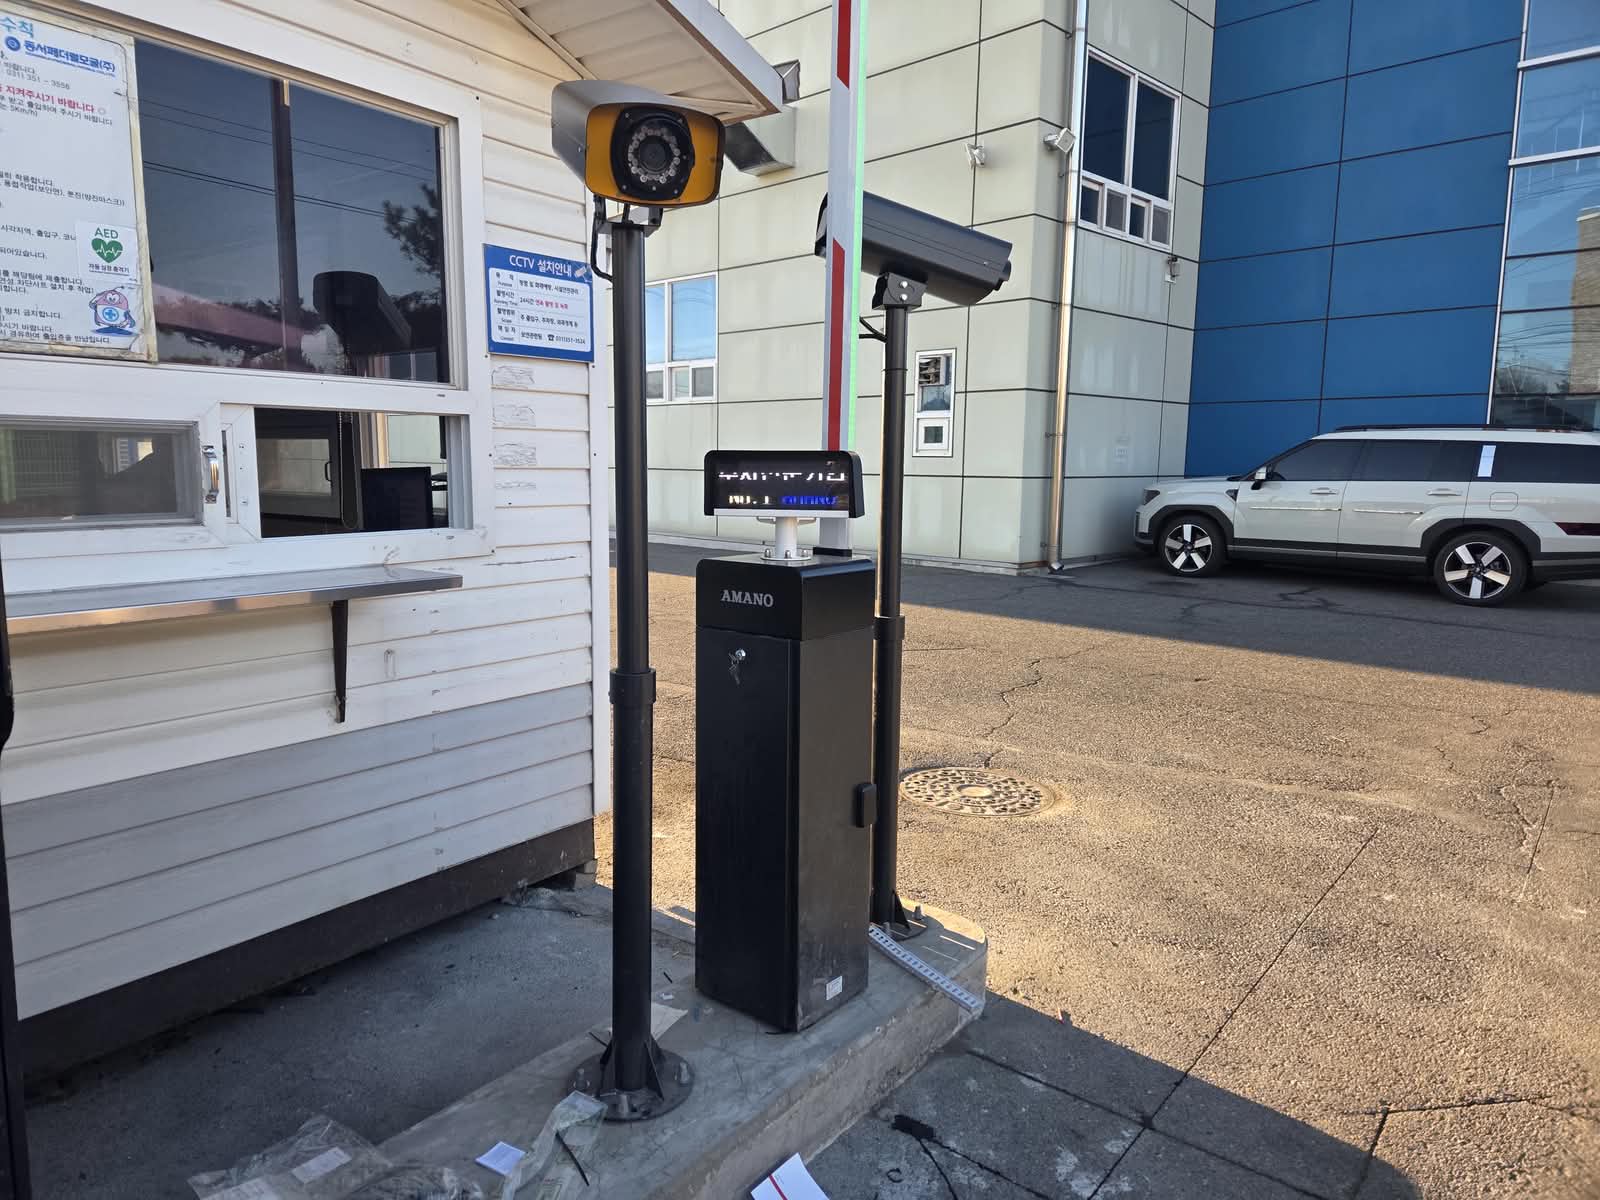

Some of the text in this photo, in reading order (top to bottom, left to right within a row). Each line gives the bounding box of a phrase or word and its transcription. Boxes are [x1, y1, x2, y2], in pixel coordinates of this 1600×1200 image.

[6, 84, 55, 103] 지켜주시기
[57, 95, 95, 113] 바랍니다
[94, 227, 119, 239] AED
[509, 255, 572, 278] CCTV 설치안내
[722, 590, 774, 607] AMANO
